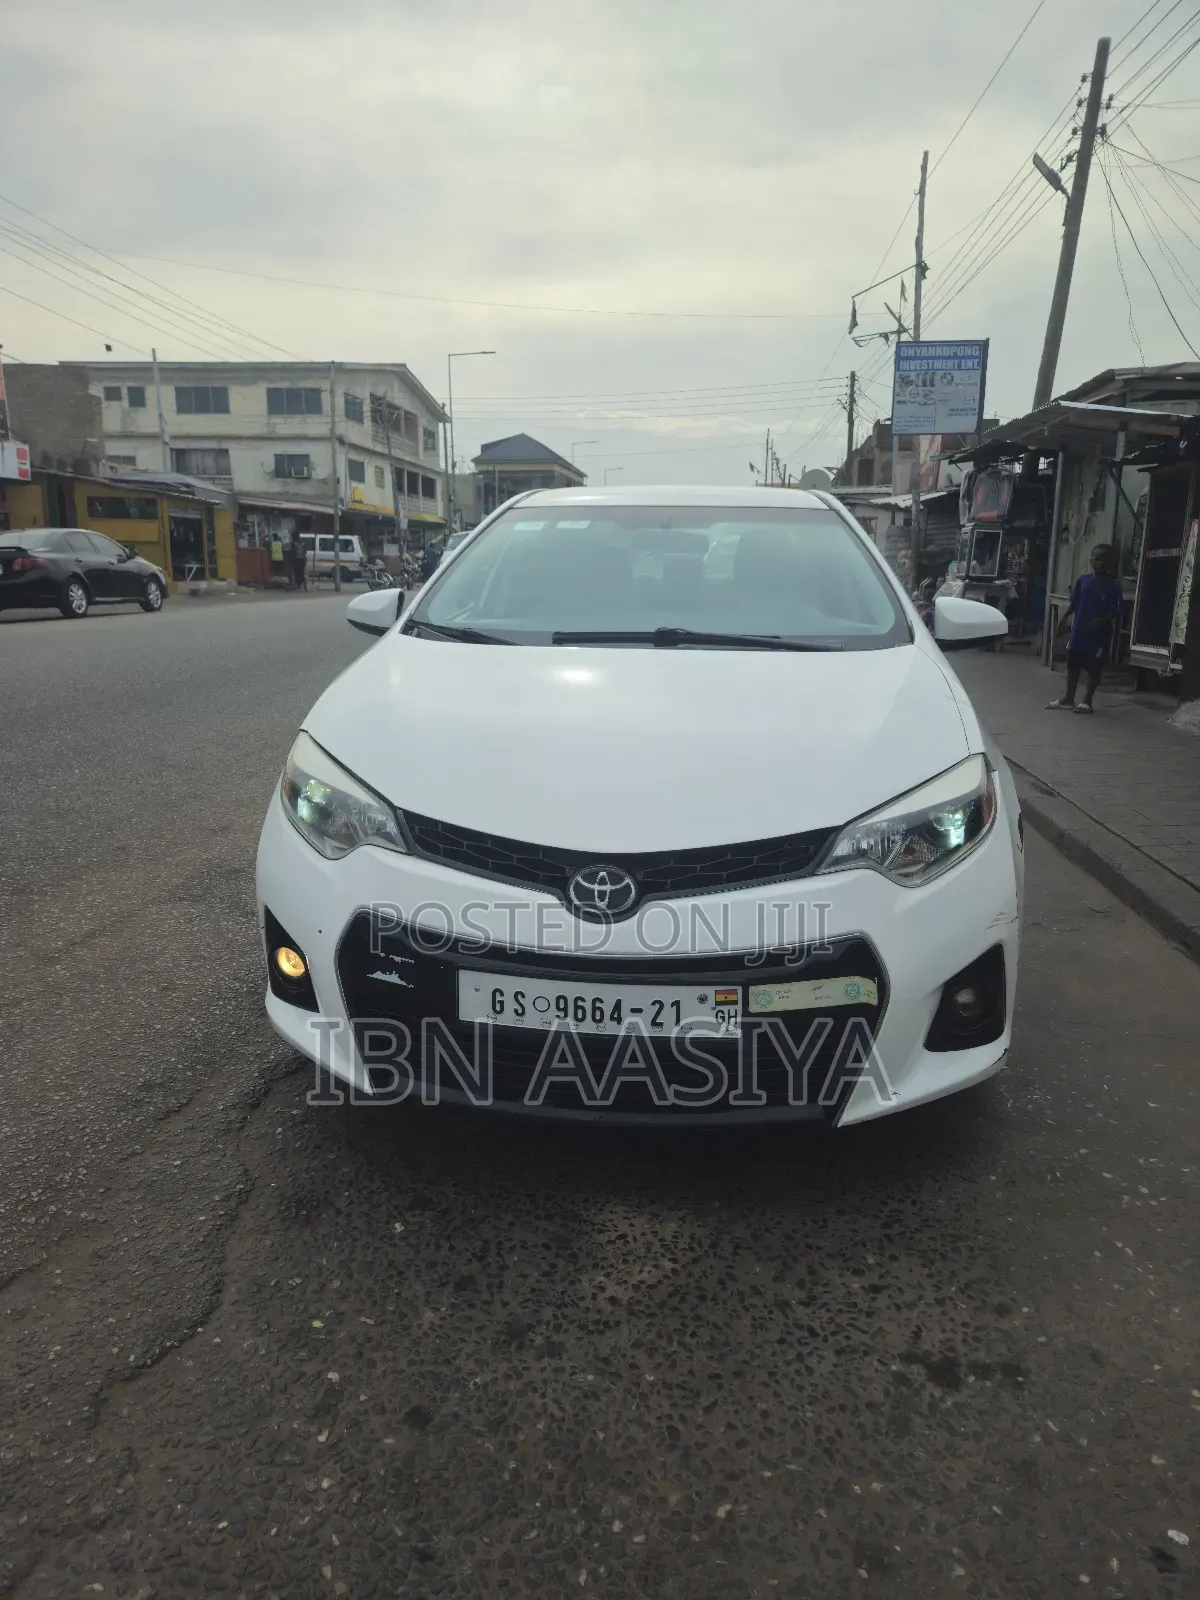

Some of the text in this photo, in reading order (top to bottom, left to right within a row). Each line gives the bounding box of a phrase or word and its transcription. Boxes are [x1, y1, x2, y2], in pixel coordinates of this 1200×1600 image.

[900, 345, 979, 357] ONYANKOPONG
[900, 359, 980, 371] INVESTMENT ENT.
[715, 1009, 738, 1025] GH
